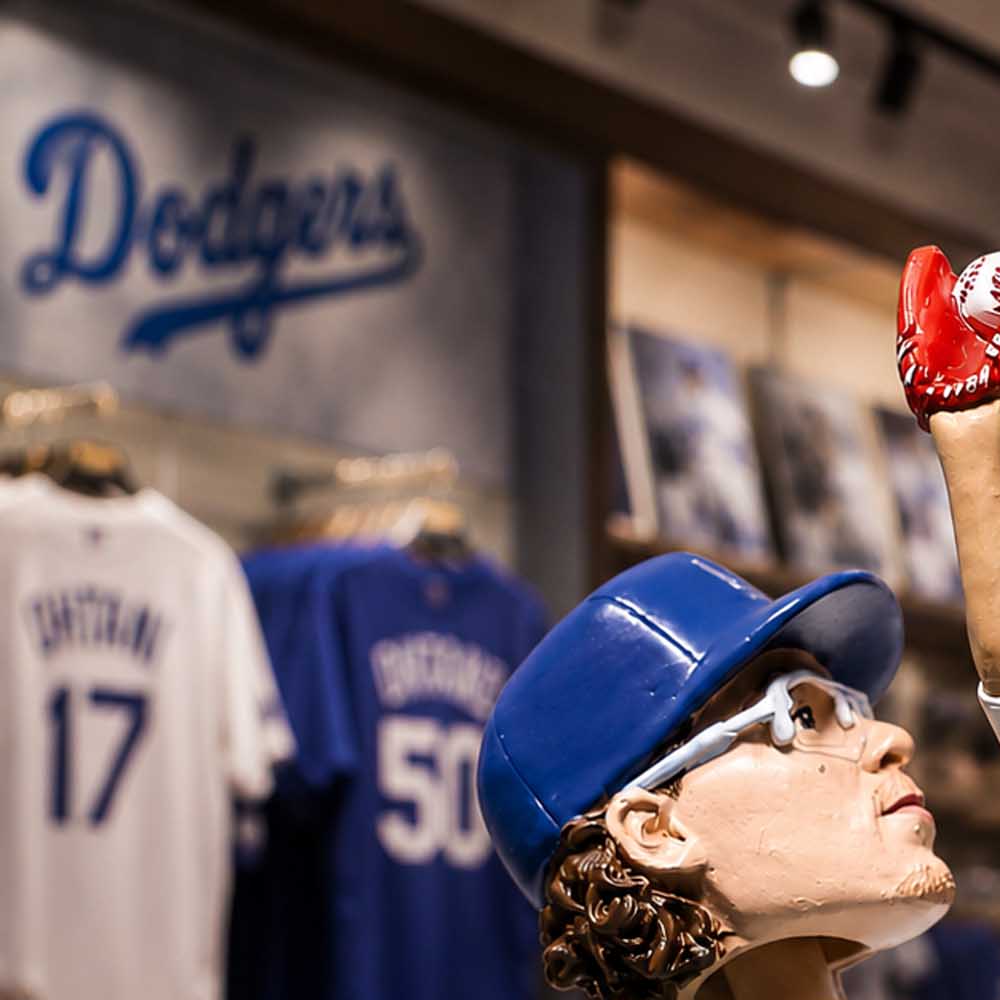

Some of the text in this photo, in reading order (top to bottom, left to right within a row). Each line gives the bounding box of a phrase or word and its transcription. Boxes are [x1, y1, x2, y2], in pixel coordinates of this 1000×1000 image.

[21, 110, 423, 362] Dodgers
[48, 687, 149, 829] 17
[376, 714, 492, 869] 50
